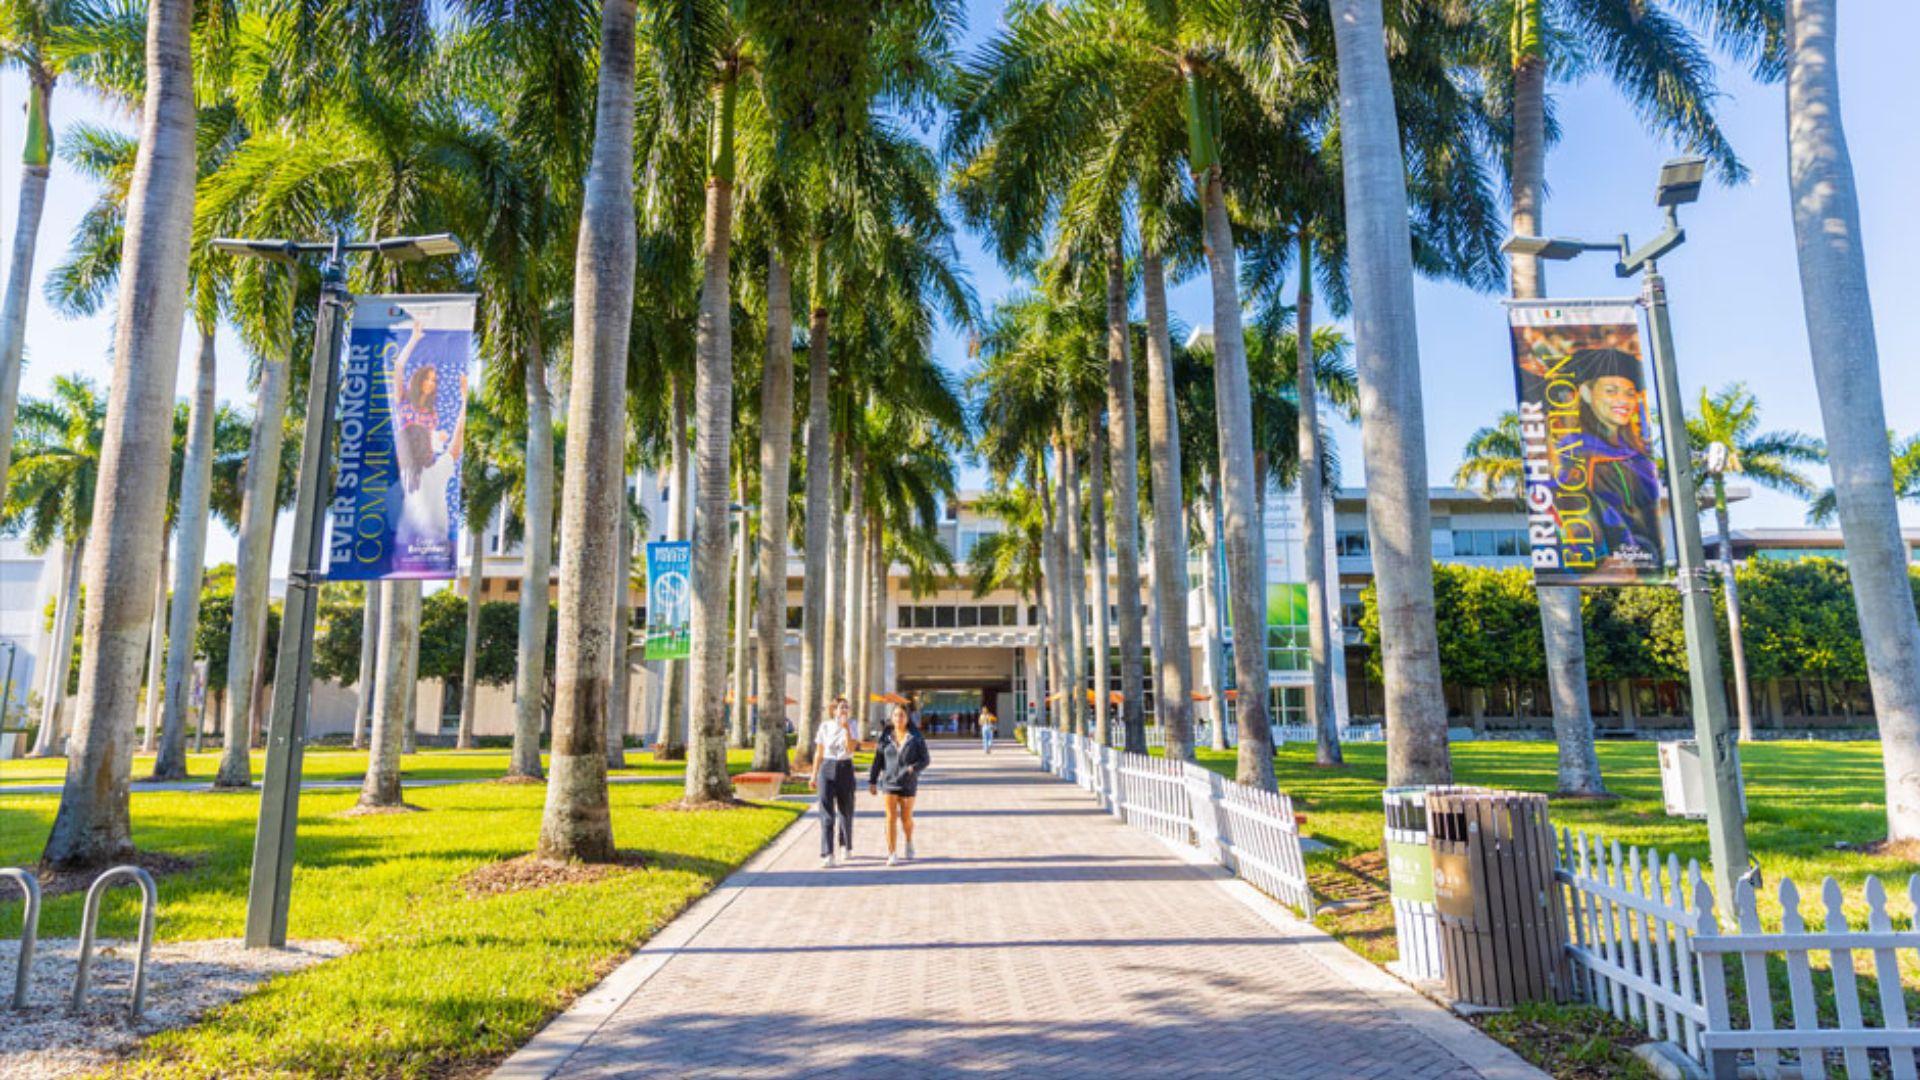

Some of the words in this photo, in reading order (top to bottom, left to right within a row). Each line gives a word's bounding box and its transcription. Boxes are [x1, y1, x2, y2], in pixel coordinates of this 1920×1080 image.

[336, 343, 371, 489] STRONGER
[354, 341, 400, 564] COMMUNITIES
[1519, 400, 1560, 569] BRIGHTER
[1542, 353, 1597, 569] EDUCATION
[329, 496, 357, 564] EVER
